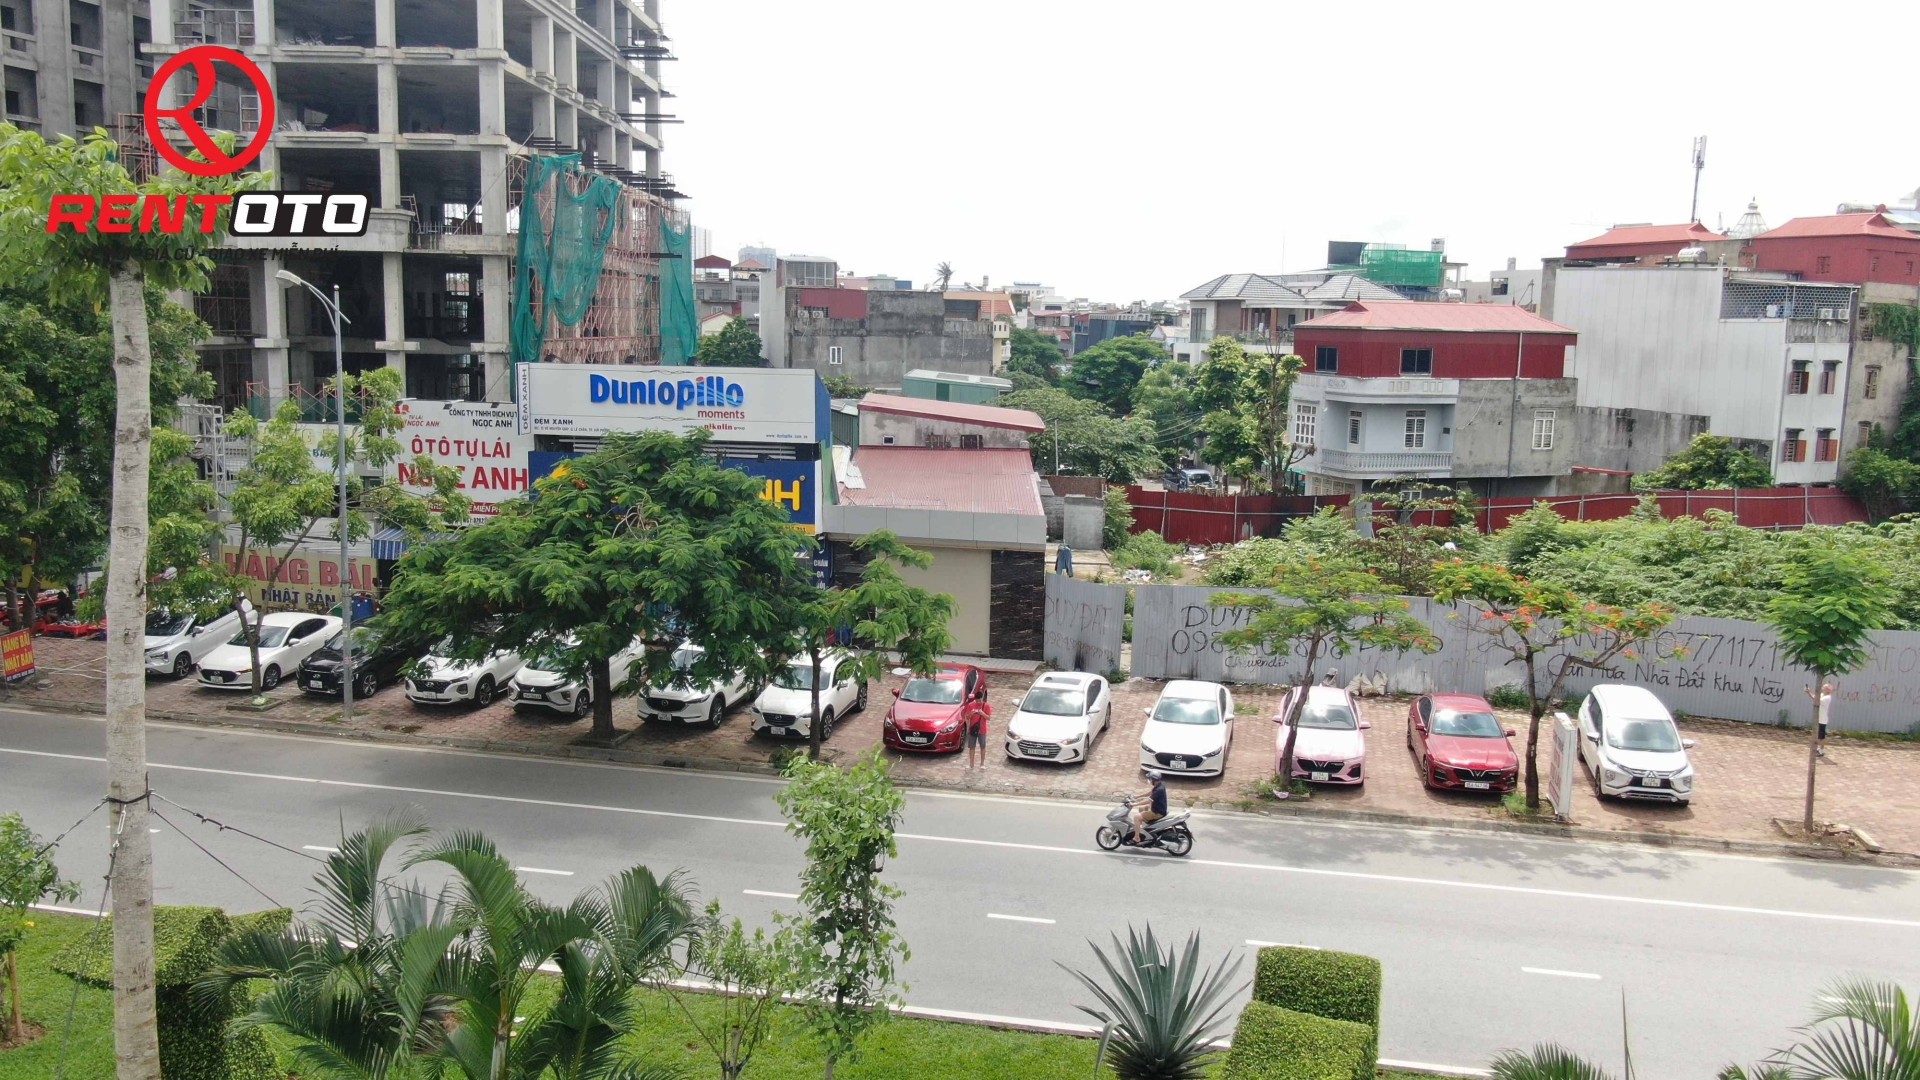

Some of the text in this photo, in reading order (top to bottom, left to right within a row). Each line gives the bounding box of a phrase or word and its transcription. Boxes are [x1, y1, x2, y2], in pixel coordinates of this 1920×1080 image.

[590, 374, 744, 410] Dunlopillo
[449, 408, 466, 417] CÔNG
[466, 409, 474, 417] TY
[475, 410, 491, 418] TNHH
[492, 410, 506, 419] DỊCH
[472, 419, 513, 430] NGỌC ANH
[697, 410, 745, 419] moments
[453, 438, 478, 461] TỰ
[481, 437, 511, 458] LÁI
[471, 466, 529, 490] ANH
[224, 550, 309, 585] HÀNG
